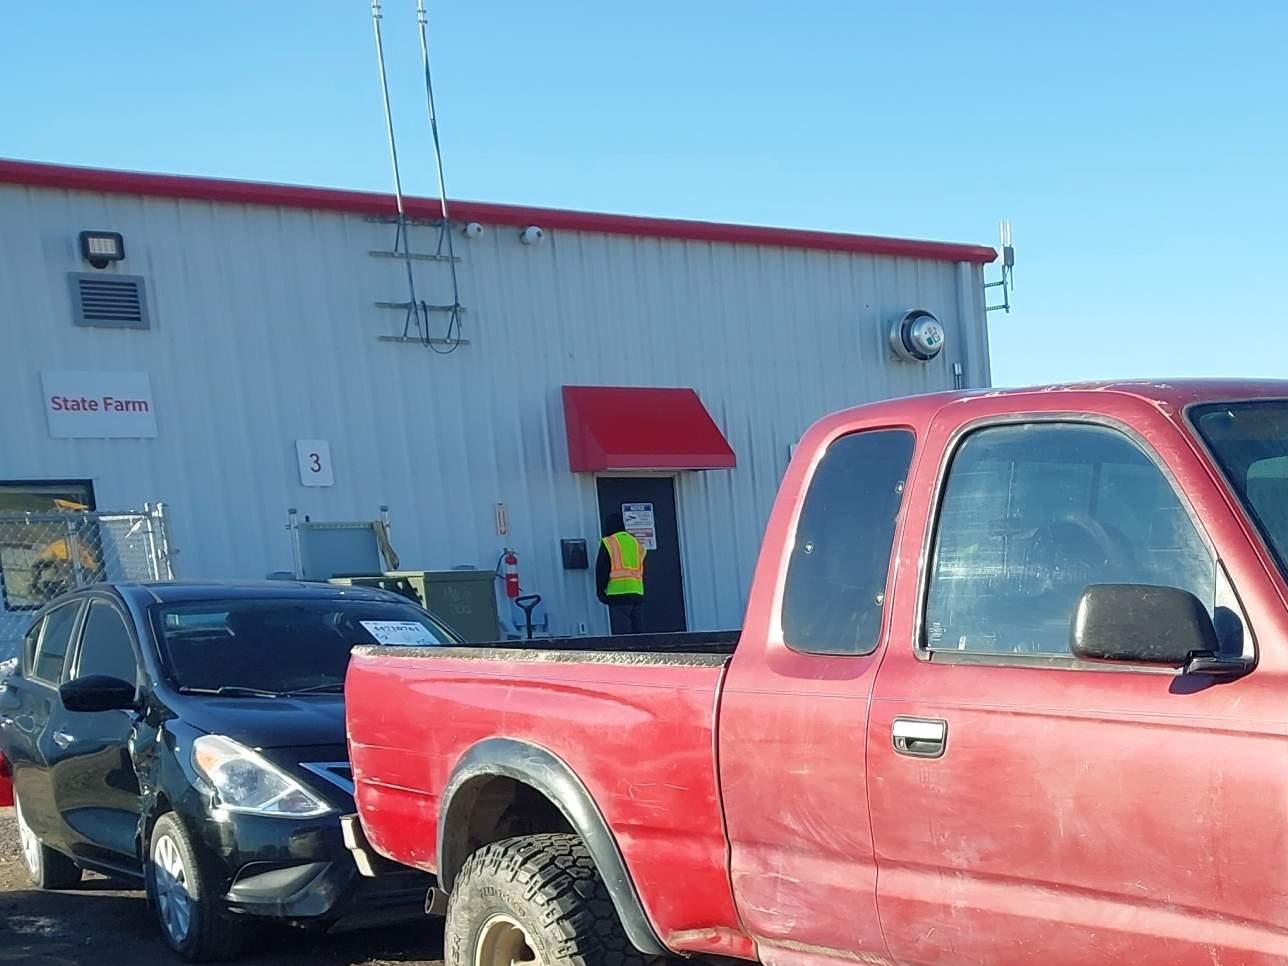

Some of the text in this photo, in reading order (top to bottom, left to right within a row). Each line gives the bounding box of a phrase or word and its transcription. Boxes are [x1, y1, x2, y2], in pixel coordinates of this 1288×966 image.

[51, 396, 149, 412] State Farm
[310, 453, 321, 473] 3
